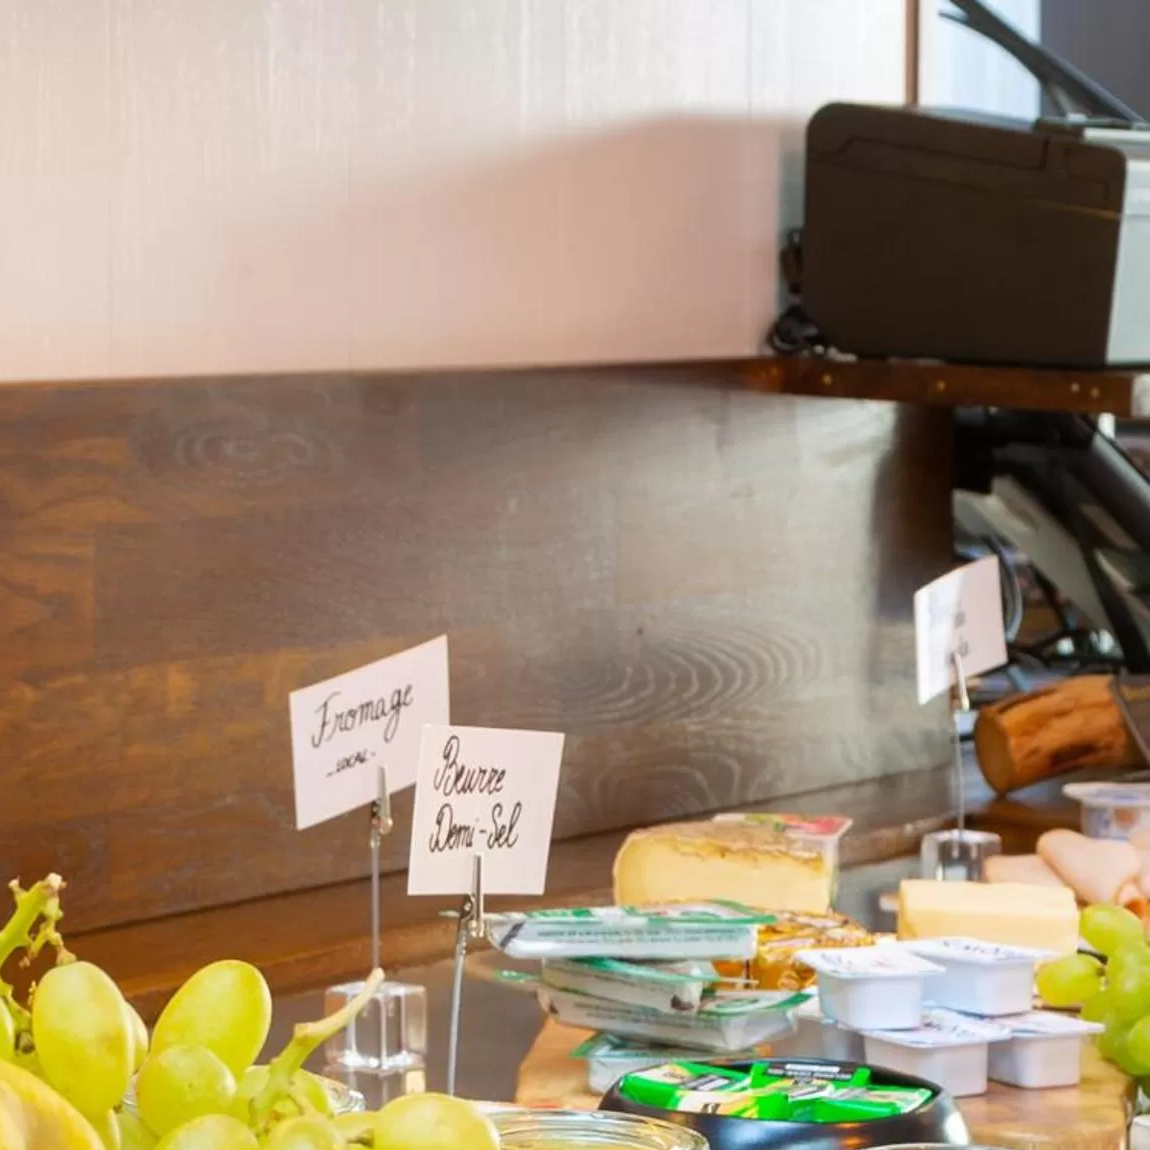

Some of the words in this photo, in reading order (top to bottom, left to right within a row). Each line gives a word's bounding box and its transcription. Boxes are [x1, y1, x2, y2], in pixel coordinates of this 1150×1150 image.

[311, 683, 414, 749] Fromage
[433, 735, 507, 797] Beurre
[429, 800, 523, 853] Demi-Sel
